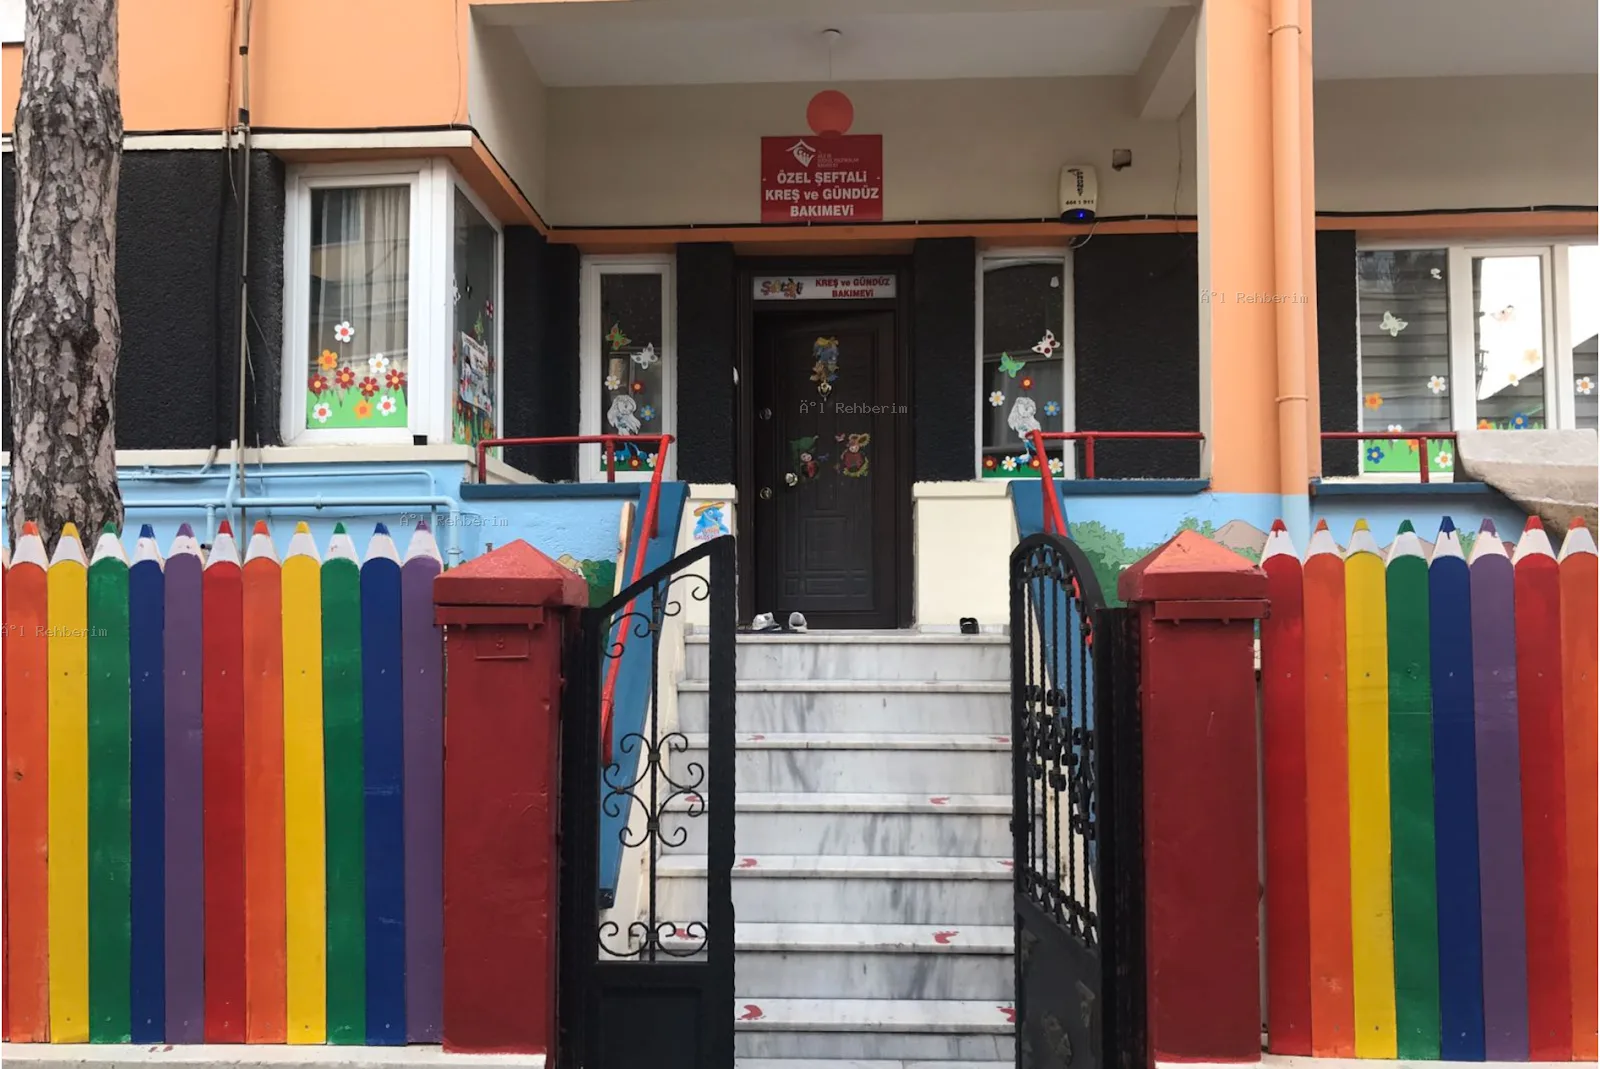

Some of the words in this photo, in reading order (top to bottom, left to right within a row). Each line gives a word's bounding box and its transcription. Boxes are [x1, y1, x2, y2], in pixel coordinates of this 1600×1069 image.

[777, 169, 811, 184] ÖZEL
[765, 189, 800, 203] KREŞ
[804, 191, 819, 200] ve
[822, 185, 879, 200] GÜNDÜZ
[815, 278, 838, 288] KREŞ
[853, 276, 890, 286] GÜNDÜZ
